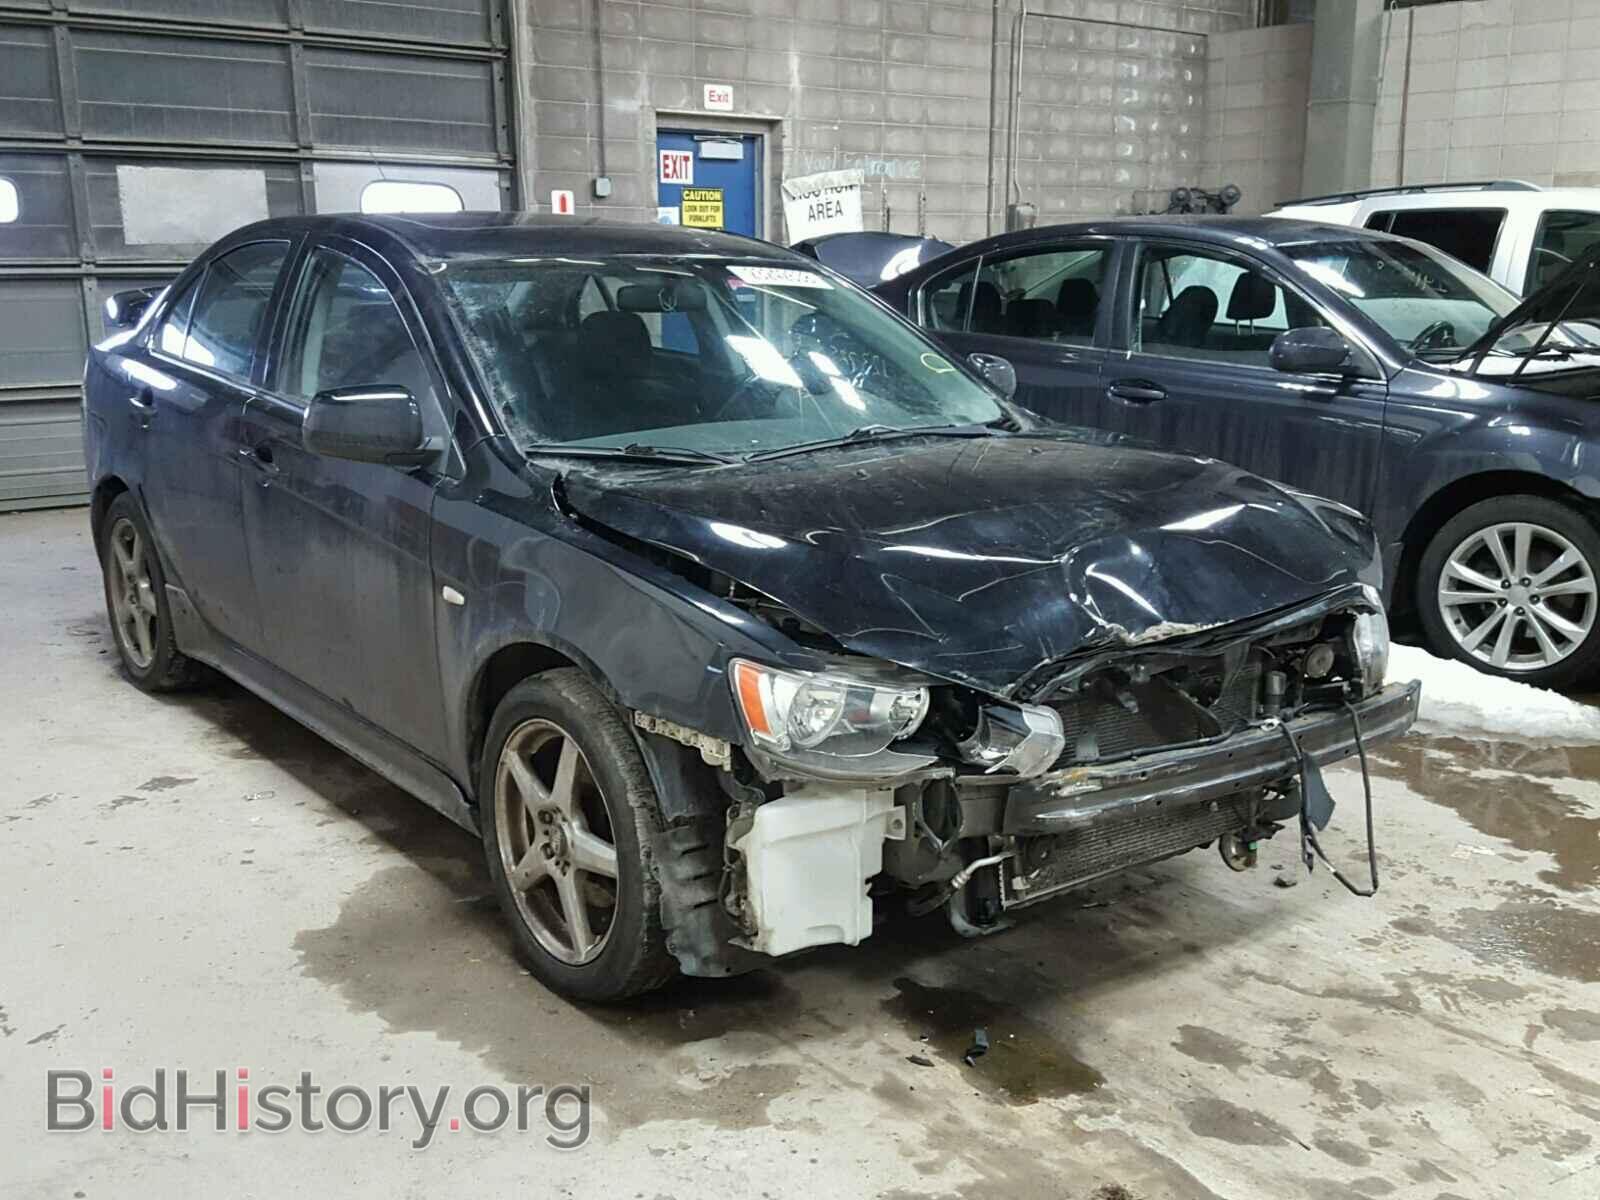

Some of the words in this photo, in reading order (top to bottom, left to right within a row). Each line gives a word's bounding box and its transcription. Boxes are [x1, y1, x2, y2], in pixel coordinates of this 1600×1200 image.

[708, 90, 730, 104] Exit
[663, 154, 690, 180] EXIT
[683, 190, 722, 201] CAUTION
[808, 200, 844, 222] AREA
